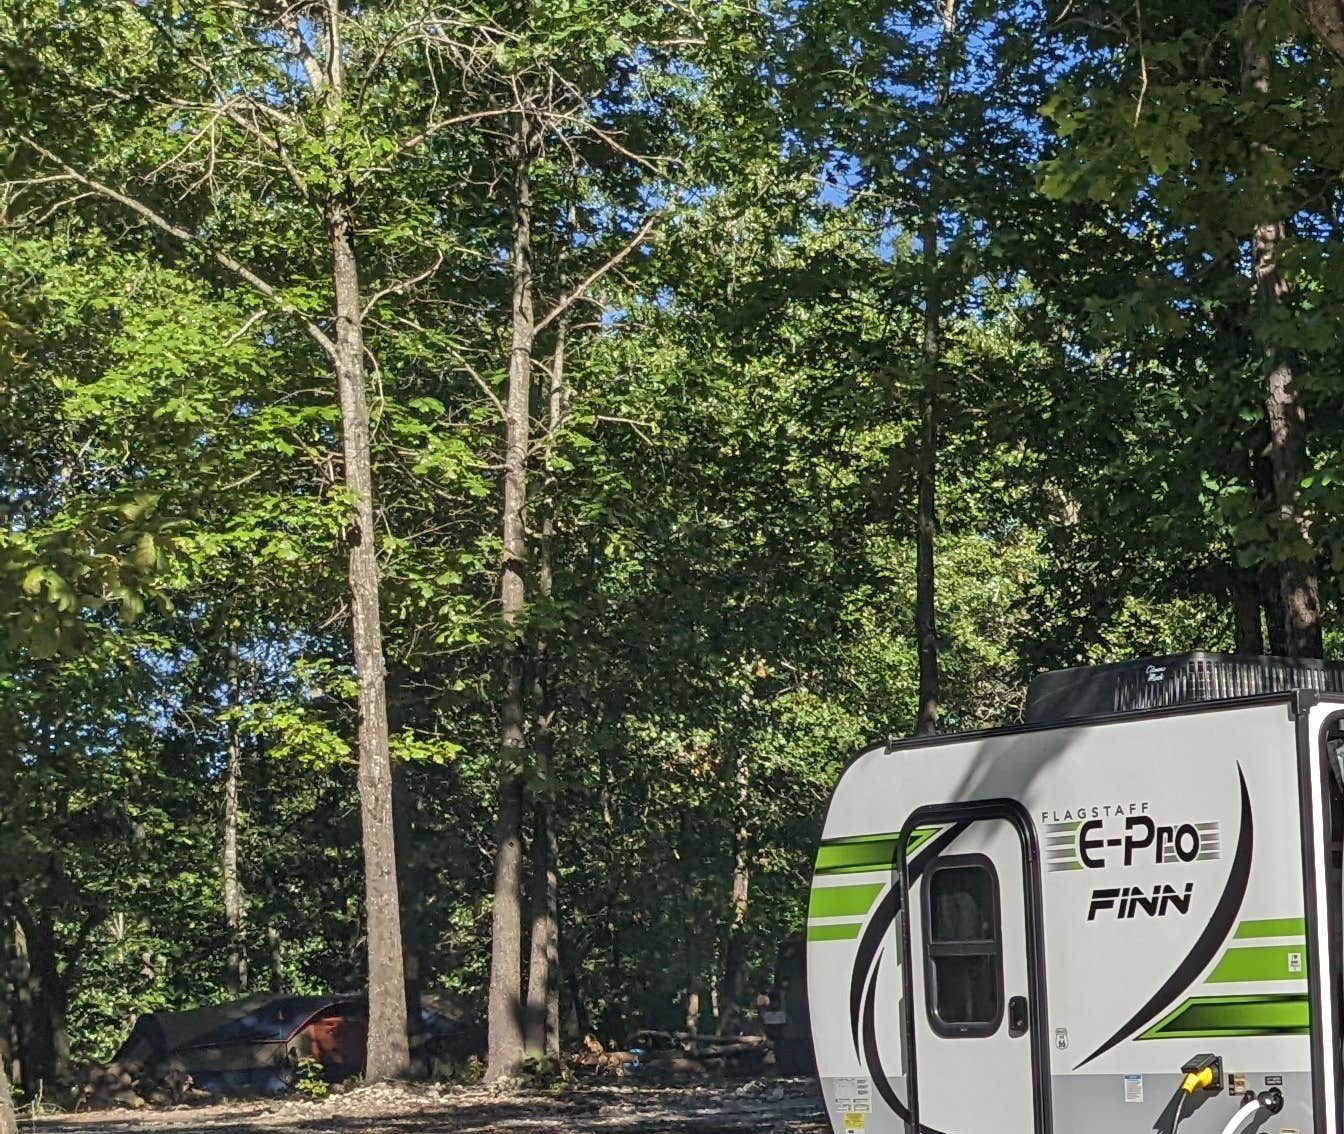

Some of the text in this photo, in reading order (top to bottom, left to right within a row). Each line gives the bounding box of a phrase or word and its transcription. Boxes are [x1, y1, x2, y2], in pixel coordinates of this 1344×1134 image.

[1042, 803, 1150, 823] FLAGSTAFF
[1079, 816, 1200, 868] E-Pro
[1087, 883, 1194, 921] FINN
